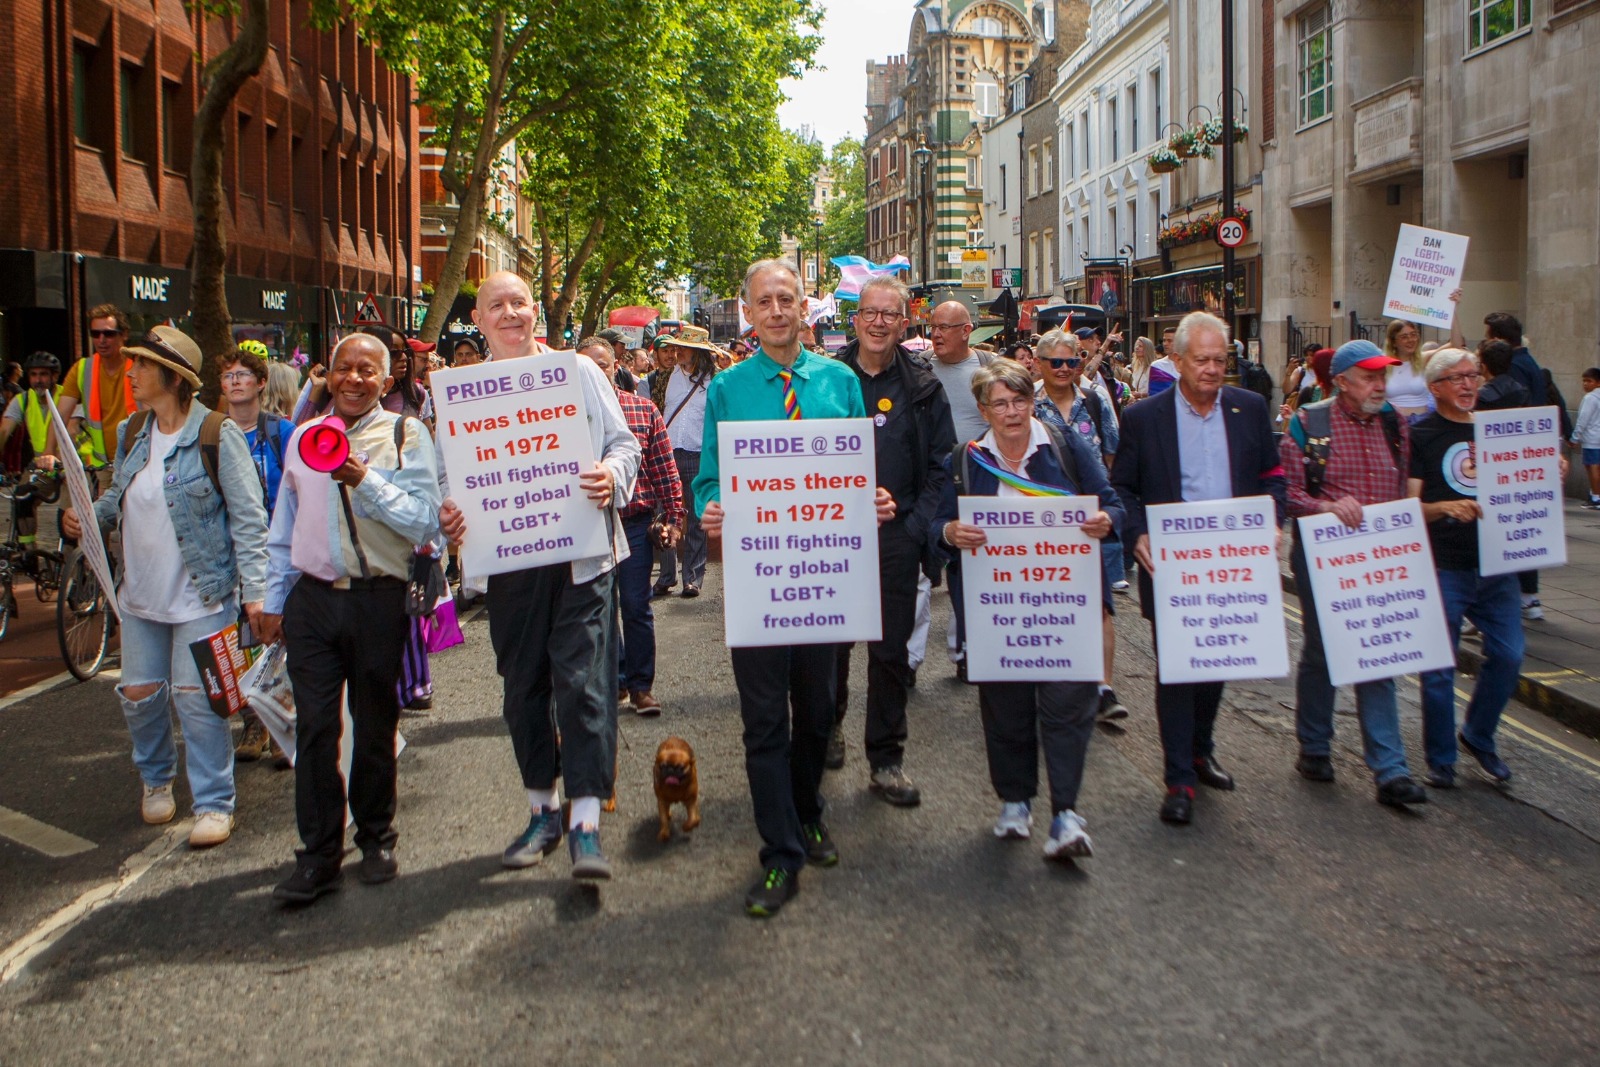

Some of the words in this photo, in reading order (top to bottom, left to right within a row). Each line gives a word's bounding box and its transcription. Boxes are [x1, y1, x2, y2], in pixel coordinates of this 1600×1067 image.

[1222, 226, 1242, 239] 20
[1423, 236, 1442, 249] BAN
[1415, 247, 1445, 261] LGBTI+
[1399, 256, 1456, 277] CONVERSION
[1405, 270, 1445, 287] THERAPY
[132, 275, 168, 301] MADE
[1410, 284, 1435, 298] NOW!
[262, 290, 286, 310] MADE
[1388, 299, 1449, 320] #ReclaimPride
[446, 376, 513, 401] PRIDE
[519, 372, 535, 390] @
[541, 367, 567, 386] 50
[448, 420, 456, 437] I
[463, 415, 510, 433] was
[516, 404, 577, 425] there
[1484, 421, 1523, 436] PRIDE
[1526, 420, 1536, 434] @
[1538, 418, 1552, 430] 50
[476, 446, 498, 462] in
[504, 433, 560, 457] 1972
[734, 437, 804, 455] PRIDE
[811, 436, 828, 454] @
[835, 435, 861, 451] 50
[1483, 451, 1488, 464] I
[1492, 449, 1518, 463] was
[1522, 446, 1555, 459] there
[465, 471, 502, 490] Still
[507, 461, 580, 485] fighting
[731, 476, 738, 492] I
[747, 477, 796, 491] was
[804, 472, 867, 490] there
[1497, 472, 1509, 485] in
[1513, 468, 1545, 483] 1972
[482, 497, 508, 512] for
[514, 485, 571, 510] global
[1489, 493, 1511, 506] Still
[1514, 490, 1554, 505] fighting
[756, 506, 778, 523] in
[786, 503, 845, 522] 1972
[973, 511, 1035, 525] PRIDE
[1041, 511, 1056, 527] @
[1062, 510, 1086, 524] 50
[1373, 517, 1386, 532] @
[1391, 512, 1412, 527] 50
[1497, 512, 1512, 524] for
[1515, 508, 1548, 525] global
[499, 511, 562, 534] LGBT+
[1162, 516, 1218, 532] PRIDE
[1224, 515, 1237, 530] @
[1242, 513, 1264, 527] 50
[741, 536, 779, 551] Still
[786, 533, 862, 552] fighting
[1506, 528, 1542, 542] LGBT+
[496, 536, 574, 559] freedom
[984, 543, 1027, 556] was
[1035, 541, 1092, 556] there
[1160, 548, 1166, 561] I
[1173, 548, 1212, 560] was
[1219, 544, 1270, 558] there
[1316, 557, 1322, 570] I
[1328, 552, 1366, 568] was
[1372, 541, 1422, 560] there
[1503, 547, 1547, 561] freedom
[755, 562, 783, 577] for
[789, 559, 849, 578] global
[993, 569, 1011, 582] in
[1019, 567, 1071, 582] 1972
[1182, 572, 1199, 585] in
[1206, 568, 1253, 584] 1972
[1339, 577, 1357, 590] in
[1363, 566, 1409, 586] 1972
[770, 586, 836, 602] LGBT+
[979, 592, 1014, 605] Still
[1019, 592, 1087, 607] fighting
[1169, 595, 1201, 608] Still
[1206, 592, 1268, 608] fighting
[1331, 597, 1361, 613] Still
[1366, 588, 1426, 607] fighting
[763, 613, 845, 628] freedom
[992, 614, 1016, 626] for
[1022, 613, 1075, 628] global
[1182, 616, 1204, 627] for
[1210, 612, 1258, 629] global
[1345, 618, 1366, 631] for
[1372, 608, 1419, 629] global
[212, 636, 226, 654] FOR
[1006, 635, 1064, 647] LGBT+
[1195, 634, 1248, 648] LGBT+
[1360, 630, 1412, 648] LGBT+
[226, 630, 246, 670] RIGHTS
[216, 653, 232, 676] FIGHT
[1000, 656, 1072, 669] freedom
[1190, 655, 1257, 669] freedom
[1357, 650, 1423, 669] freedom
[223, 673, 236, 691] AND
[226, 688, 240, 712] UNITE
